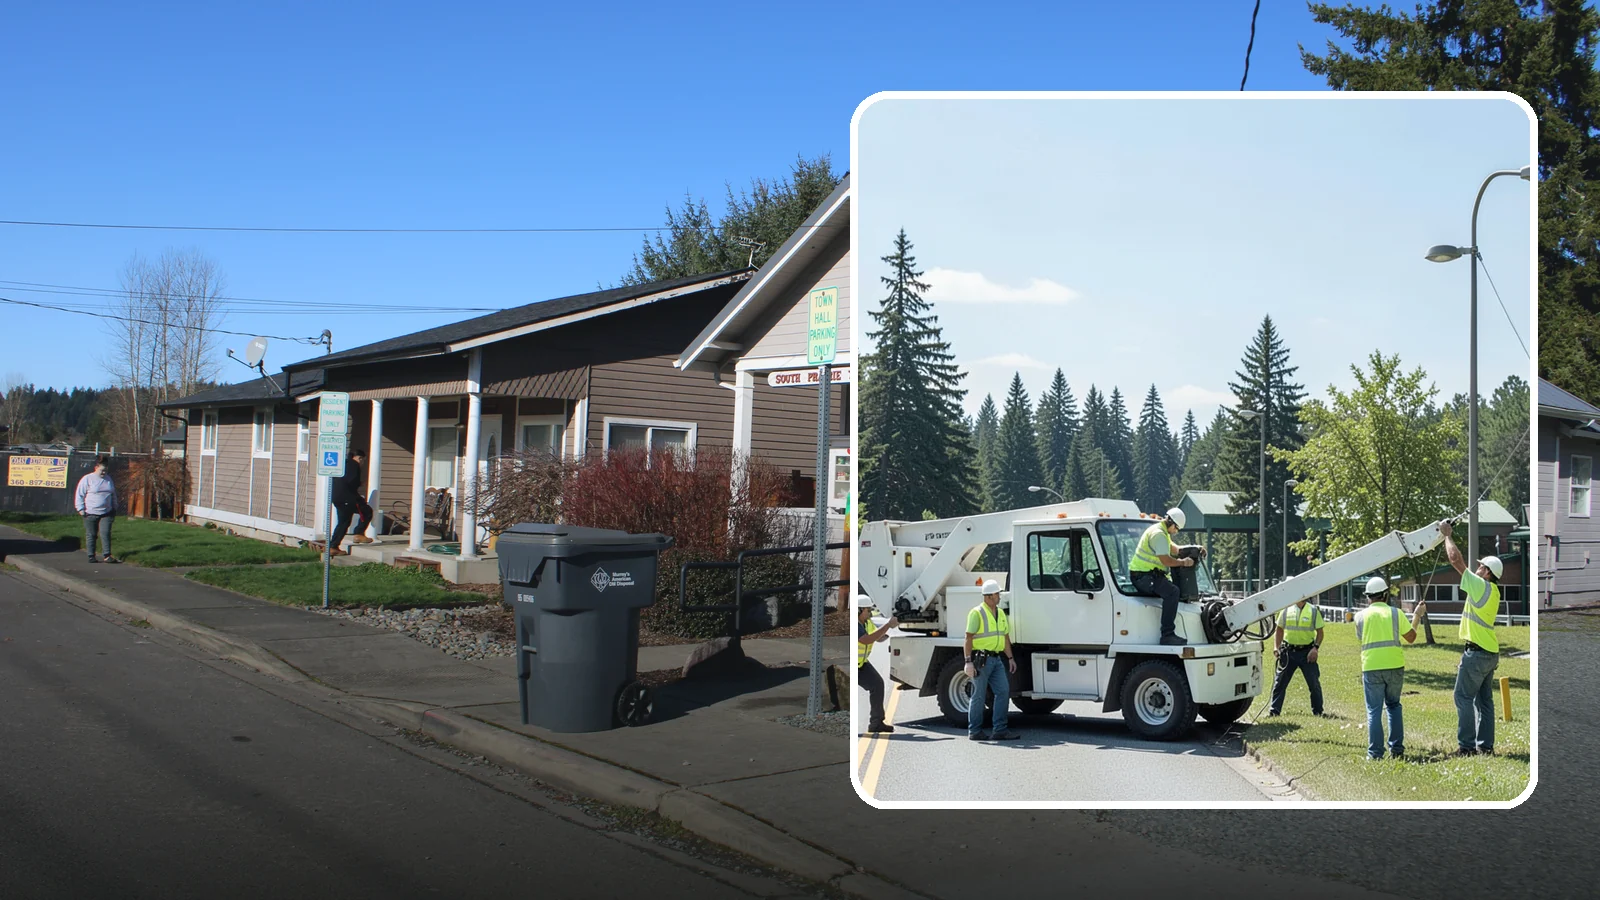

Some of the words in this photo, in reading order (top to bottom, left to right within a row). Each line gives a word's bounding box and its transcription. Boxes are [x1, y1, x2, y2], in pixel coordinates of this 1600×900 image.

[815, 294, 833, 308] TOWN
[814, 312, 831, 324] HALL
[810, 326, 836, 341] PARKING
[814, 344, 831, 357] ONLY
[775, 373, 801, 384] SOUTH
[12, 457, 26, 465] COAST
